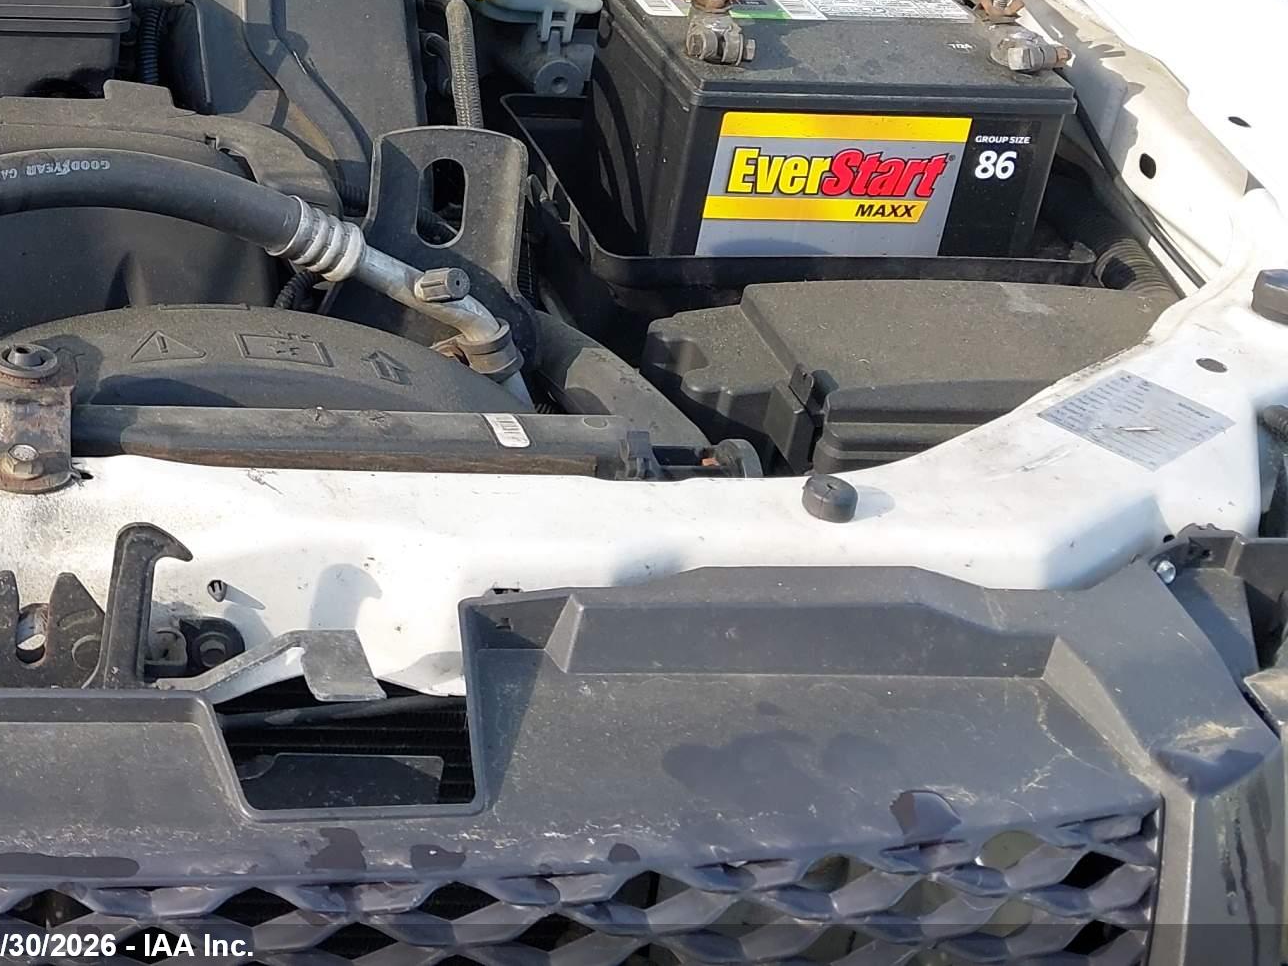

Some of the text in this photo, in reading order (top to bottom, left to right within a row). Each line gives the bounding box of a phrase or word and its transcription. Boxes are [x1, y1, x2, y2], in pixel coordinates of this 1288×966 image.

[974, 135, 1030, 144] GROUP SIZE
[25, 159, 110, 176] GOODYEAR
[725, 146, 949, 198] EverStart
[974, 150, 1017, 180] 86
[855, 204, 917, 219] MAXX
